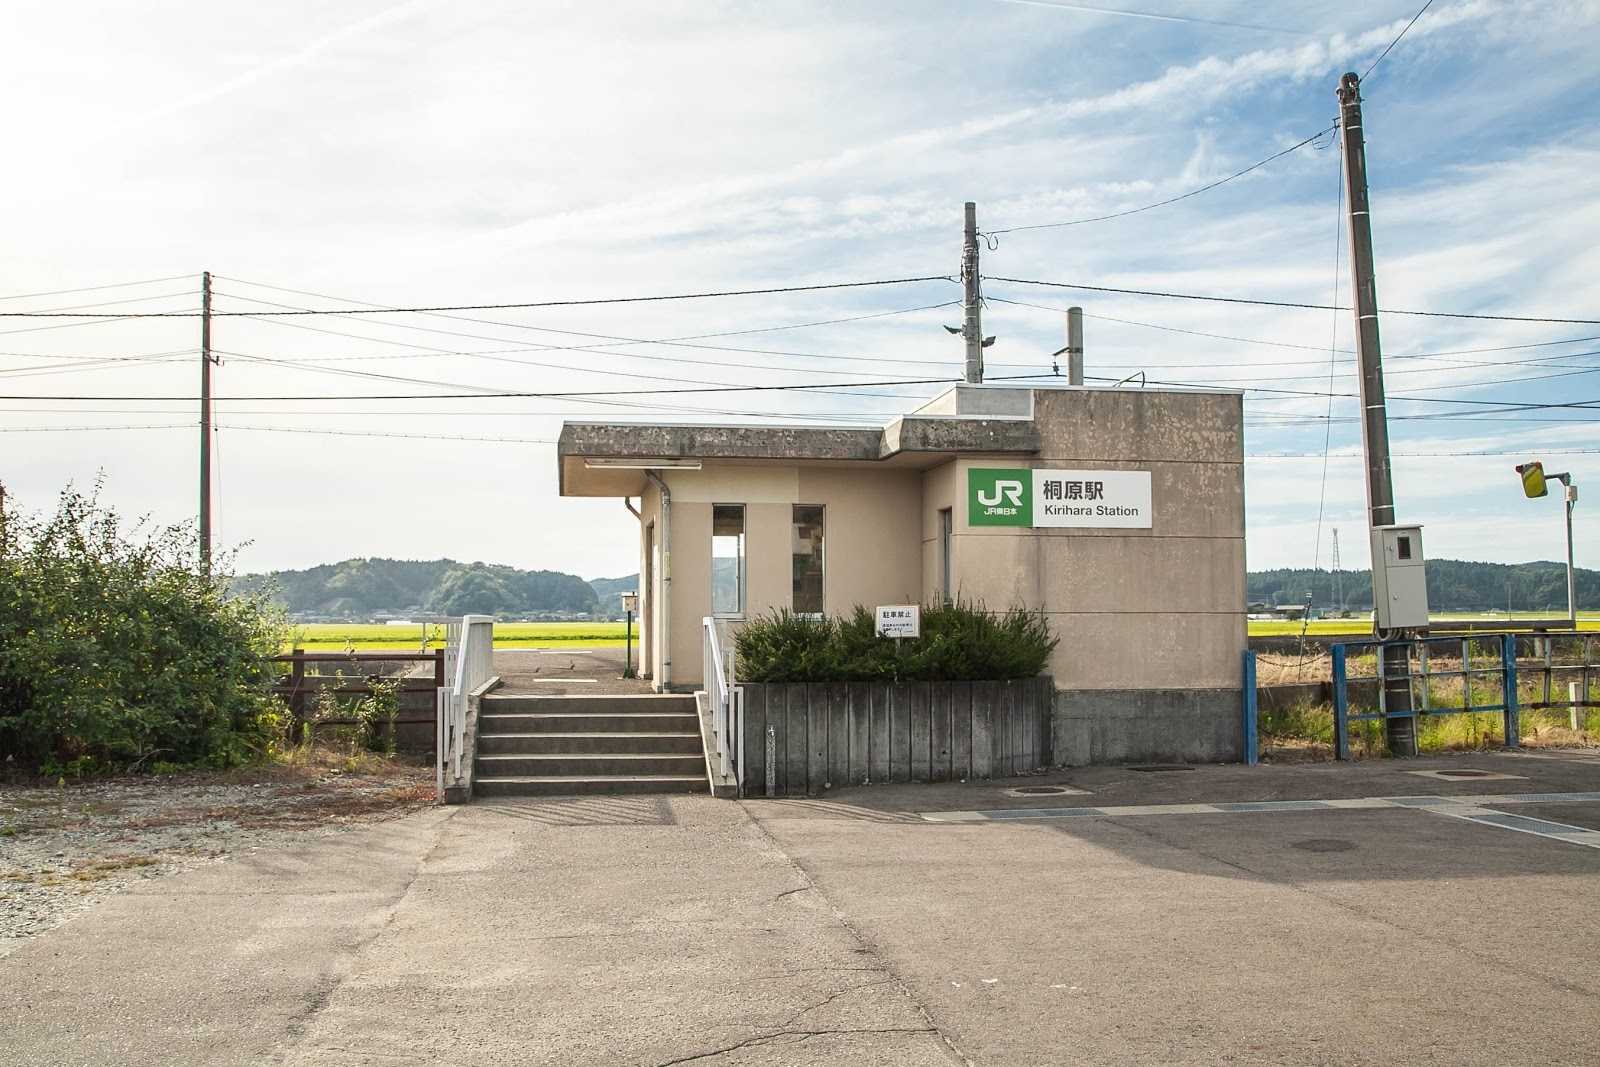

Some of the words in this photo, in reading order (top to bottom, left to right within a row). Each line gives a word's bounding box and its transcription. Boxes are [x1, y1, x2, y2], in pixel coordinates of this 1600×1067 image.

[977, 480, 1023, 506] JR
[1044, 480, 1103, 500] 桐原駅
[984, 507, 1017, 515] JR東日本
[1045, 505, 1092, 516] Kirihara
[1096, 506, 1138, 516] Station
